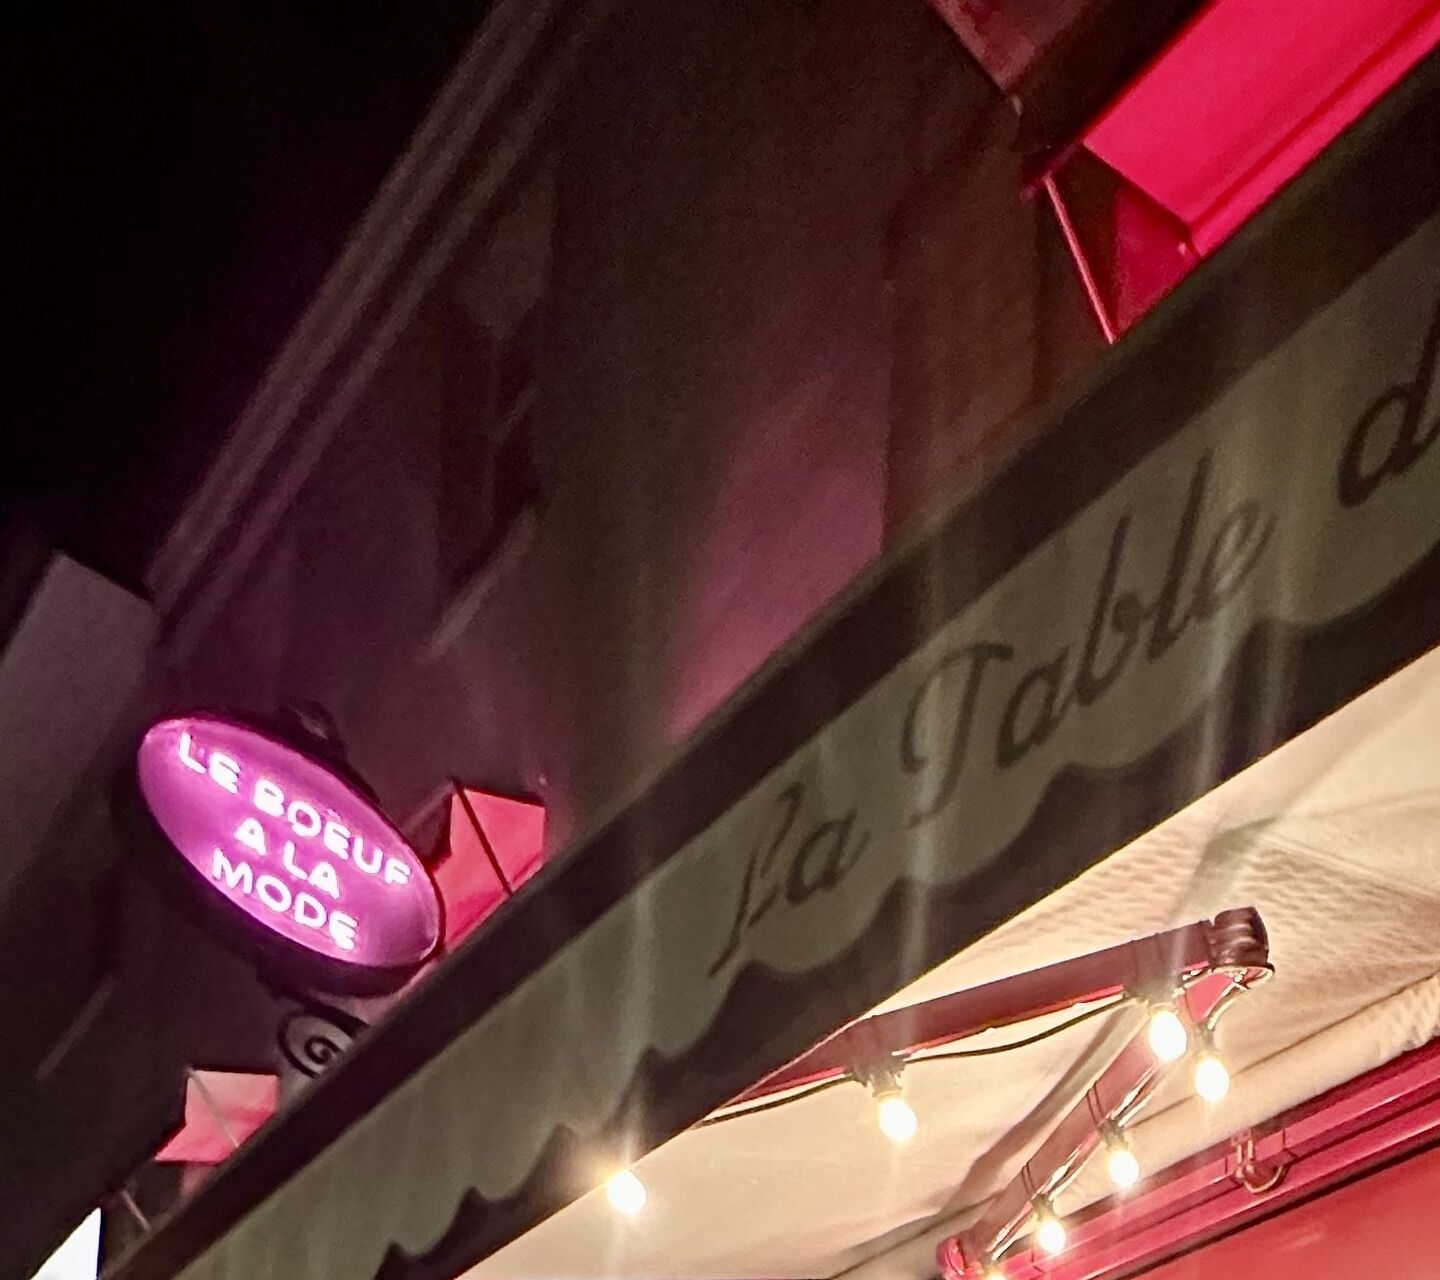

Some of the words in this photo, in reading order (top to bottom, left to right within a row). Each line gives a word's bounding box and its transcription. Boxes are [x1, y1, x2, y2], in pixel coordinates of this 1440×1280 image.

[708, 783, 870, 979] La
[903, 448, 1276, 828] Table
[178, 730, 241, 794] LE
[253, 778, 411, 885] BOEUF
[234, 817, 267, 856] A
[283, 840, 340, 899] LA
[212, 848, 358, 950] MODE
